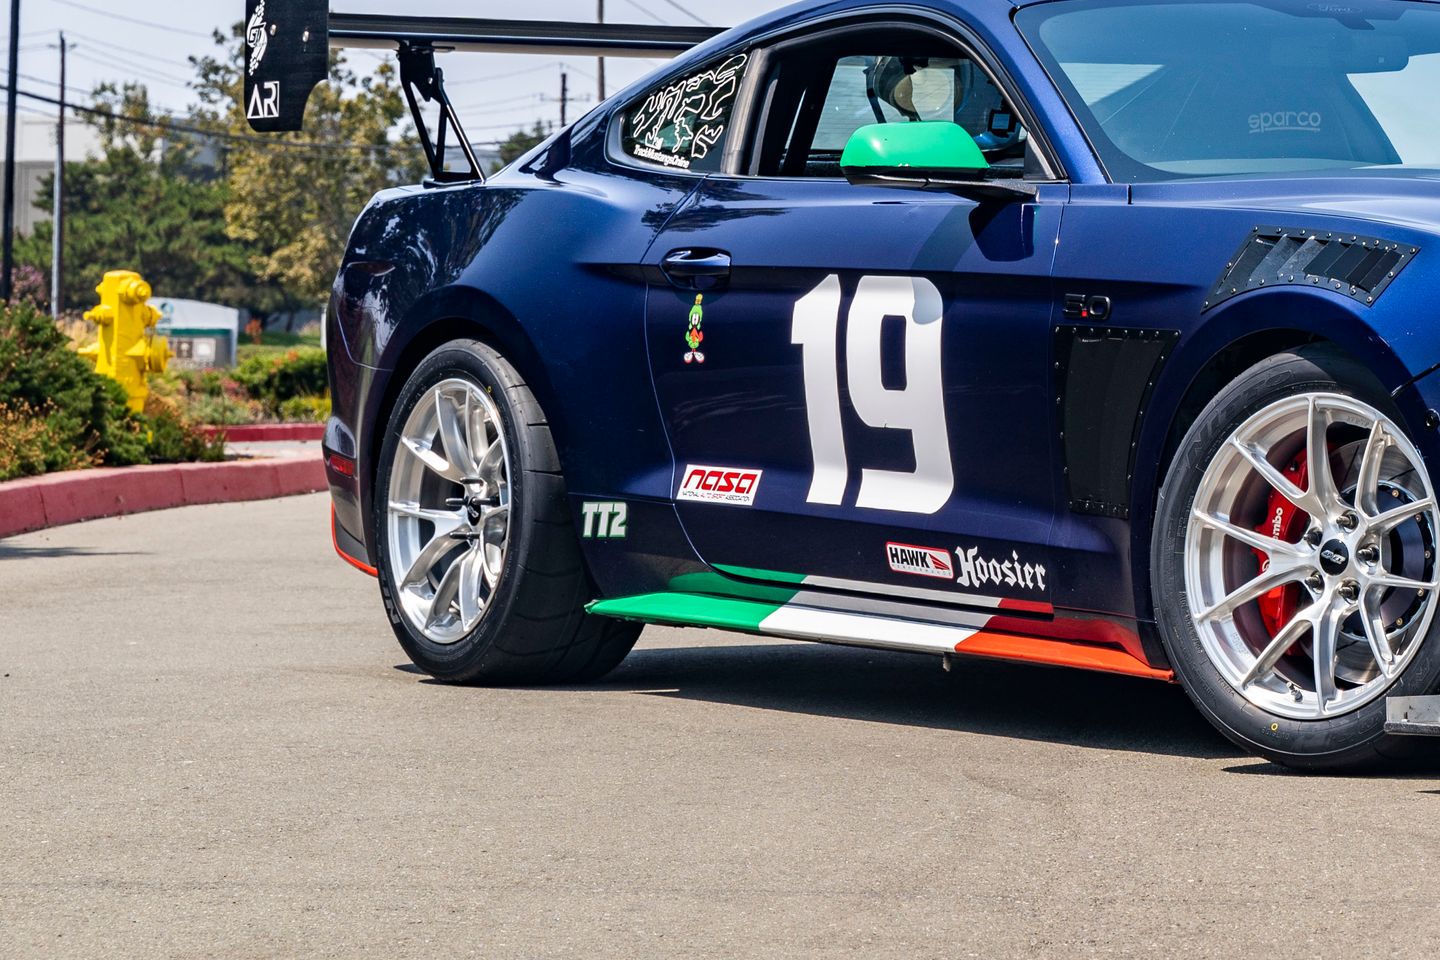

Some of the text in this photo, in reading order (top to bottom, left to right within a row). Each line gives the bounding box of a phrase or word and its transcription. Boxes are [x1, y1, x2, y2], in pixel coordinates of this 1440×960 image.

[1247, 112, 1321, 133] sparco
[1063, 293, 1111, 320] 5.0
[791, 274, 954, 514] 19
[582, 501, 627, 538] TT2
[889, 546, 930, 568] HAWK
[955, 546, 1046, 591] Hoosier
